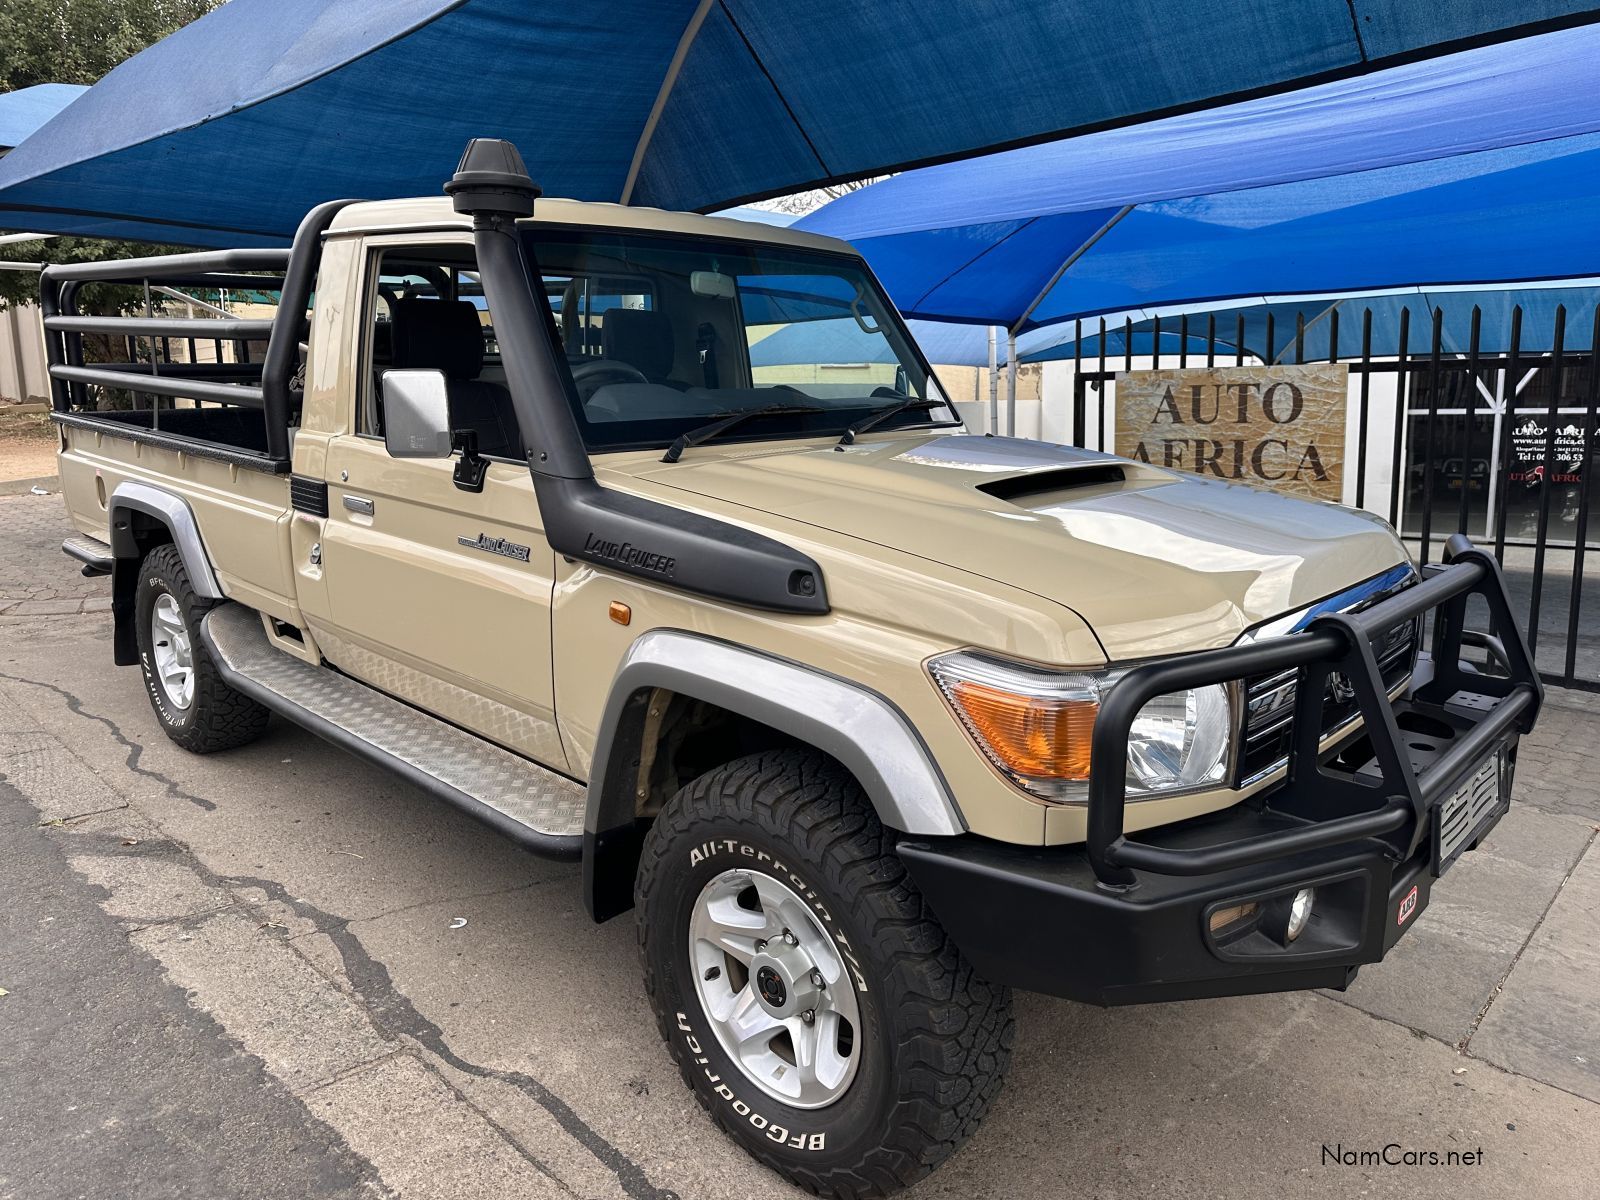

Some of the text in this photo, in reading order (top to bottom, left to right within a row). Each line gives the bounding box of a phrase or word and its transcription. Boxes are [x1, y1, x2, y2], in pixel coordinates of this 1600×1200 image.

[1151, 382, 1303, 424] AUTO
[1132, 439, 1331, 481] AFRICA
[1518, 452, 1531, 461] Tel
[1556, 453, 1571, 461] 306
[690, 840, 831, 922] All-Terrain
[836, 928, 868, 992] T/A
[676, 1011, 826, 1150] BFGoodrich
